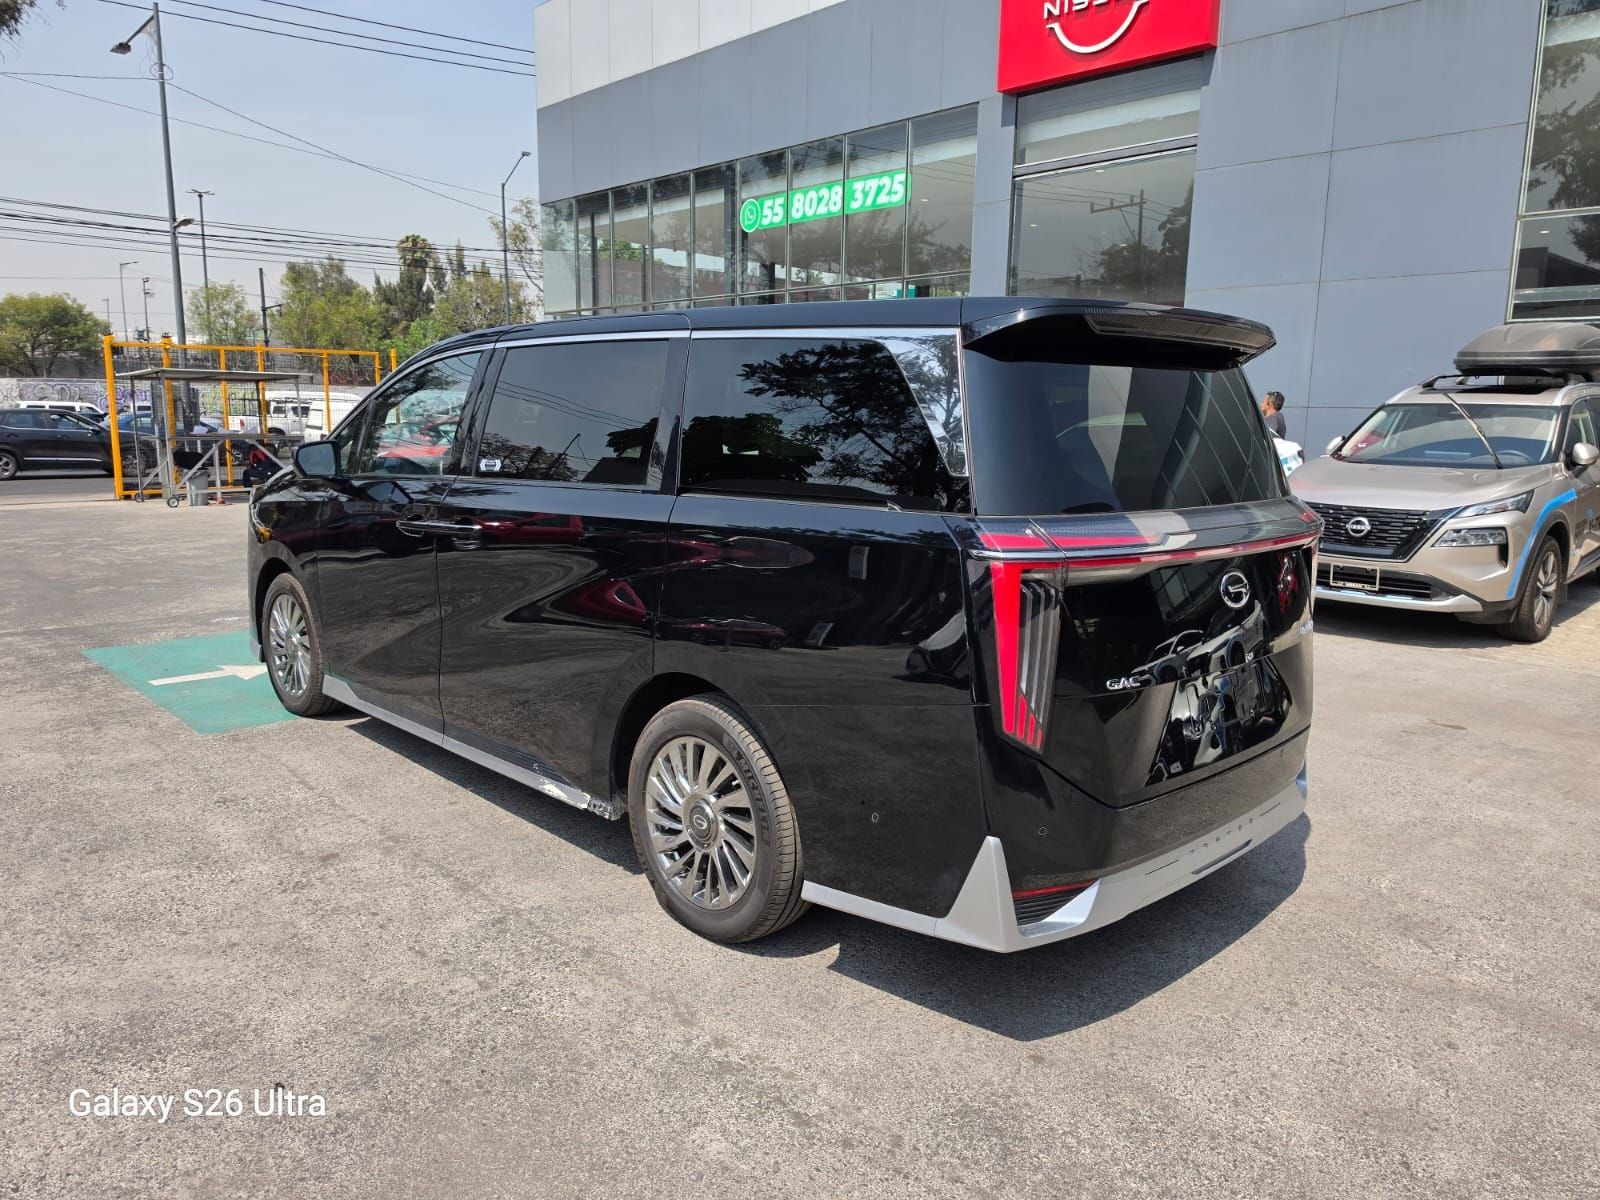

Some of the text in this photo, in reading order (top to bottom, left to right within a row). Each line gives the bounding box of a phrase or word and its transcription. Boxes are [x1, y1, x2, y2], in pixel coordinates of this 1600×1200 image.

[761, 173, 907, 226] 55 8028 3725
[1106, 676, 1141, 691] GAC
